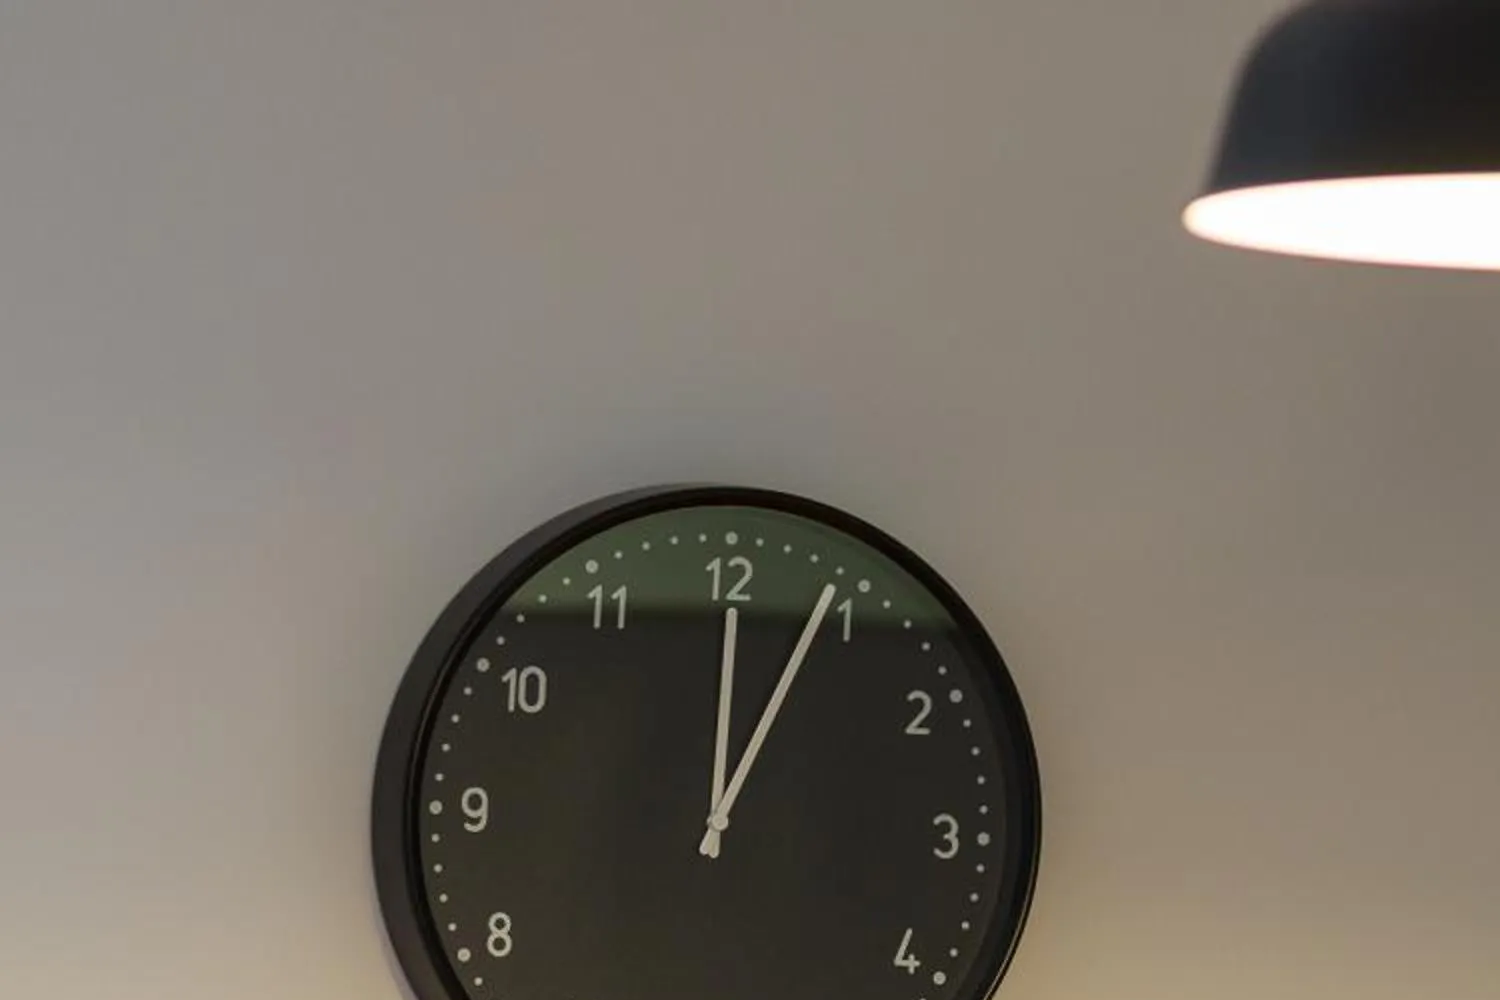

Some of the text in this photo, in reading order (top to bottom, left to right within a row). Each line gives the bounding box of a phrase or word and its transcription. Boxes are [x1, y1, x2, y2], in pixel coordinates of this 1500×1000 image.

[706, 557, 752, 601] 12
[588, 585, 626, 629] 11
[838, 599, 851, 641] 1
[502, 666, 546, 713] 10
[906, 690, 931, 734] 2
[462, 787, 488, 832] 9
[934, 814, 959, 858] 3
[487, 912, 512, 957] 8
[894, 928, 920, 974] 4
